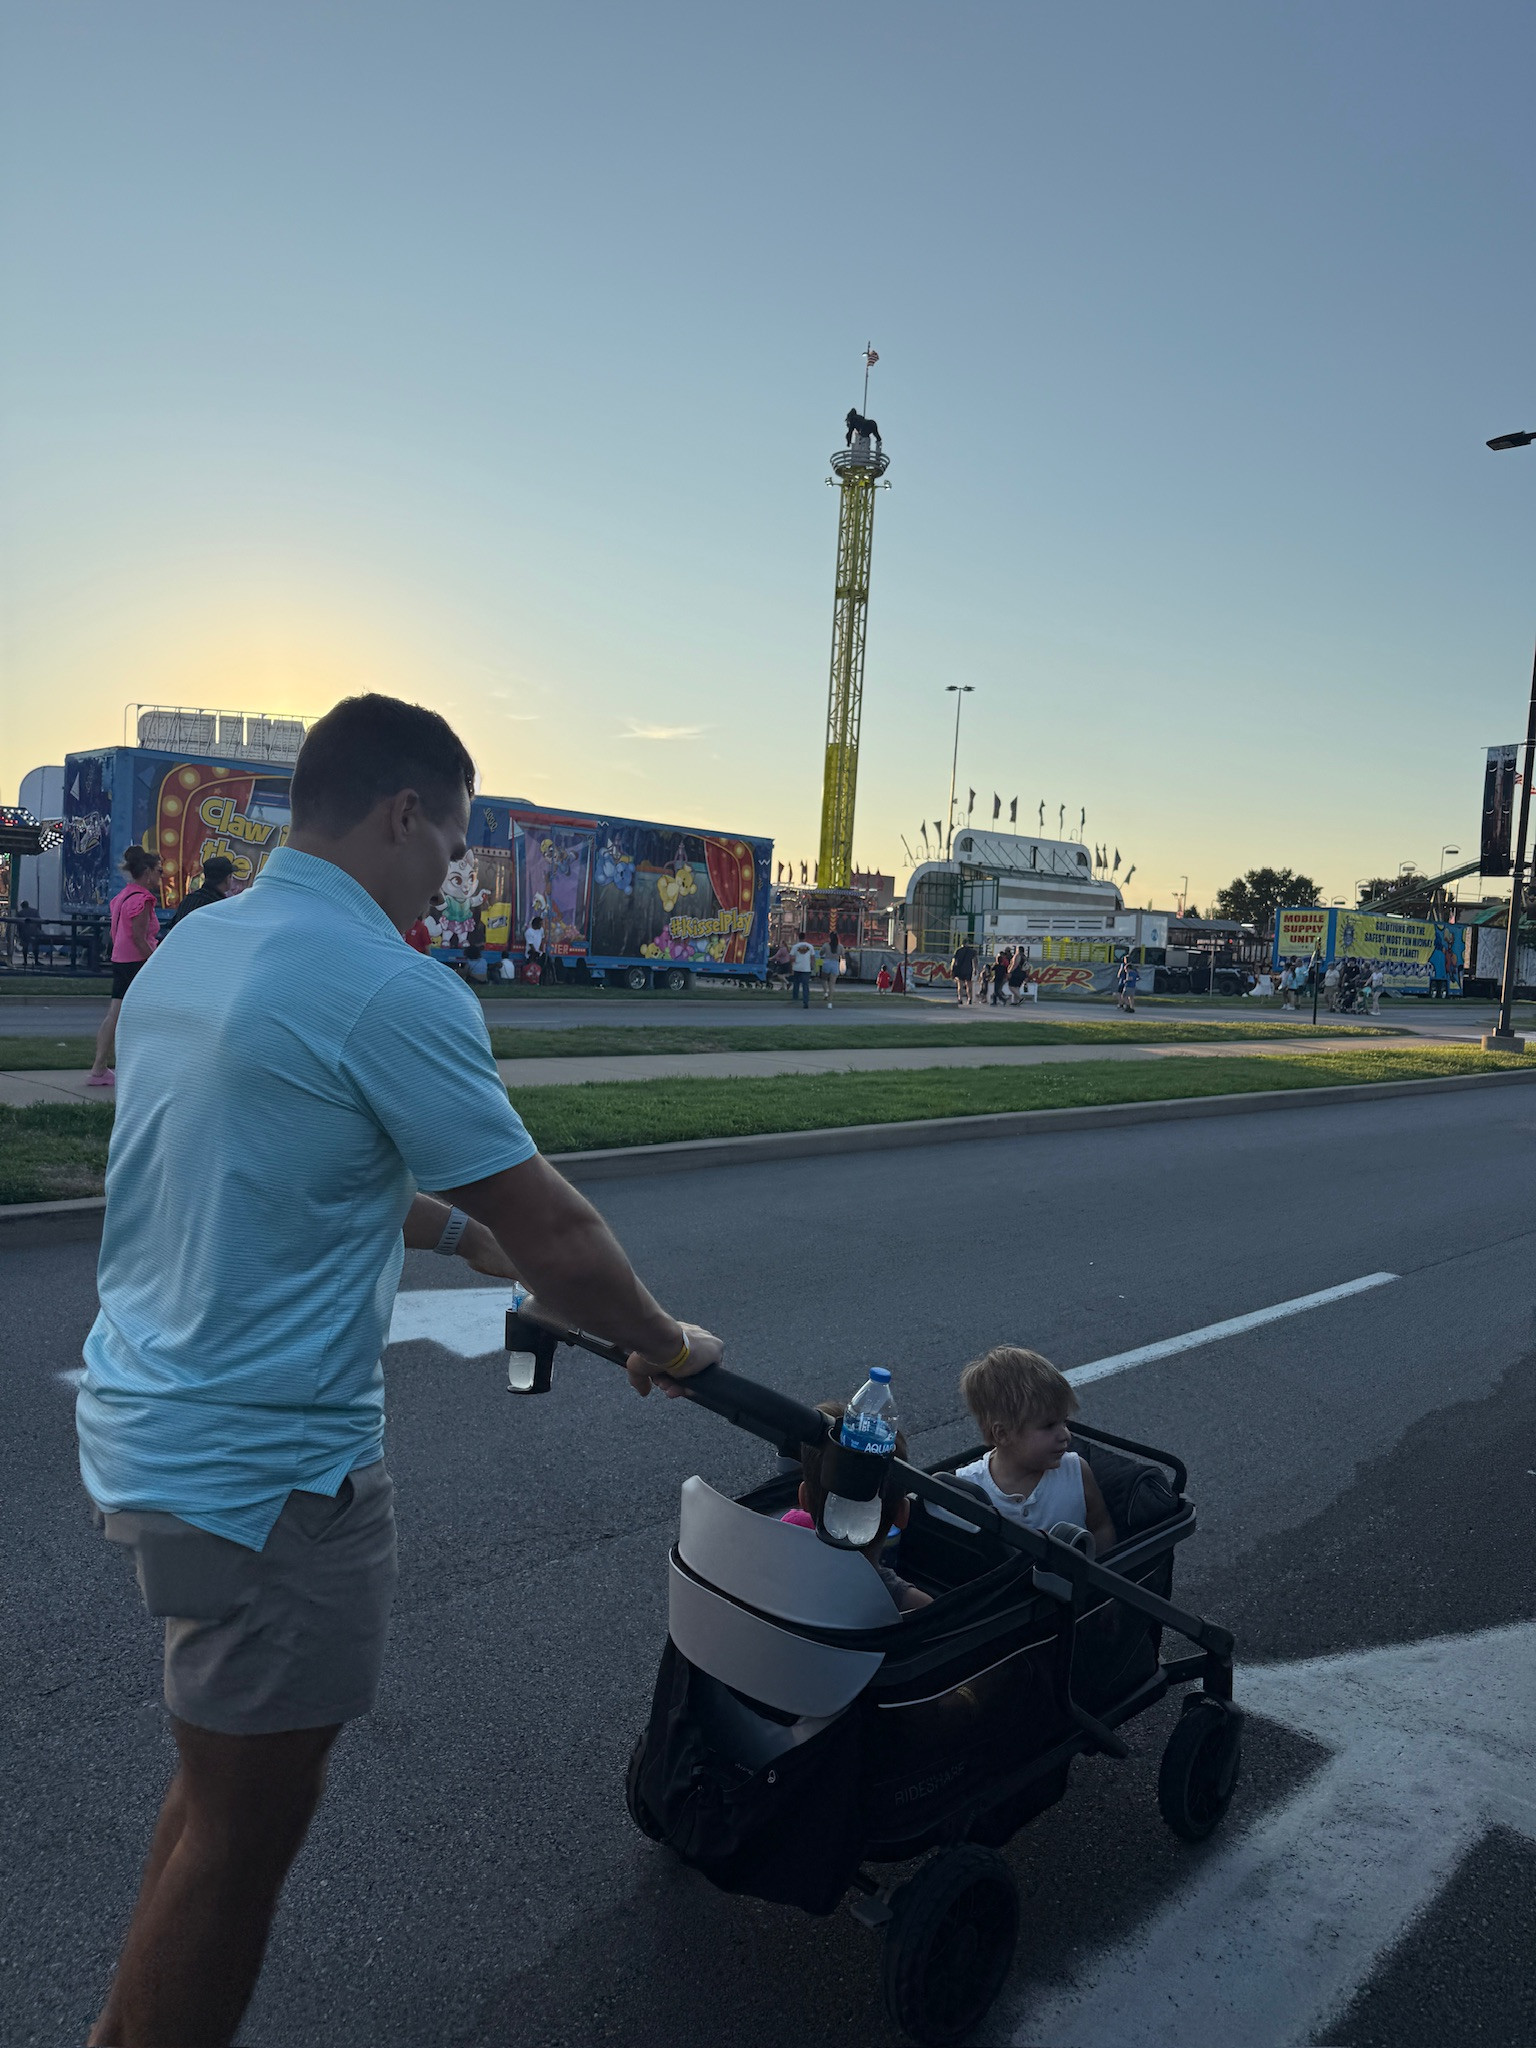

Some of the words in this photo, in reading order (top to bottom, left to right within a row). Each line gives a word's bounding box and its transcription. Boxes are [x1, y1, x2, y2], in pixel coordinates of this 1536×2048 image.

[200, 796, 275, 844] Claw
[669, 907, 755, 939] #KisselPlay
[1283, 914, 1324, 923] MOBILE
[1283, 924, 1323, 933] SUPPLY
[1416, 926, 1426, 936] THE
[1290, 935, 1316, 943] UNIT
[1364, 932, 1386, 944] SAFEST
[1386, 935, 1402, 945] MOST
[1388, 947, 1399, 957] THE
